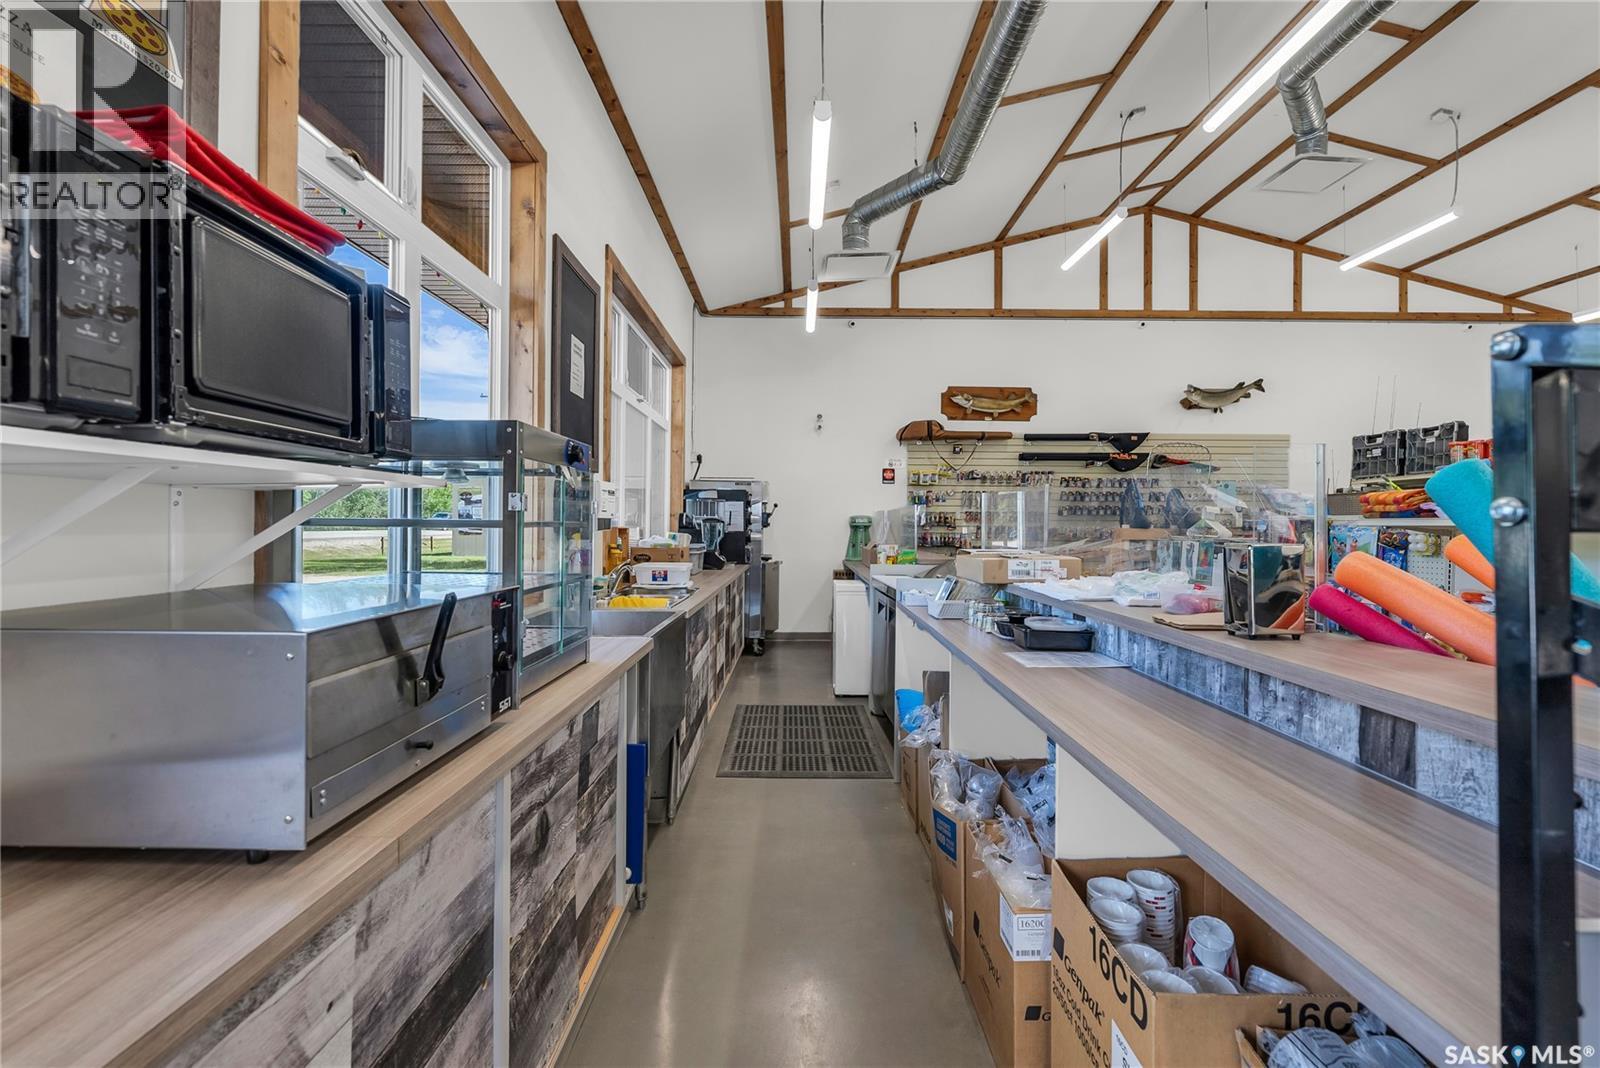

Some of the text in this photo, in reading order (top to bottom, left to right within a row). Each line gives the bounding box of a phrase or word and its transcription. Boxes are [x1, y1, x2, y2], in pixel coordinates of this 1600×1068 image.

[1064, 955, 1104, 1027] Genpak
[1089, 925, 1148, 1031] 16CD
[1277, 1001, 1364, 1036] 16C
